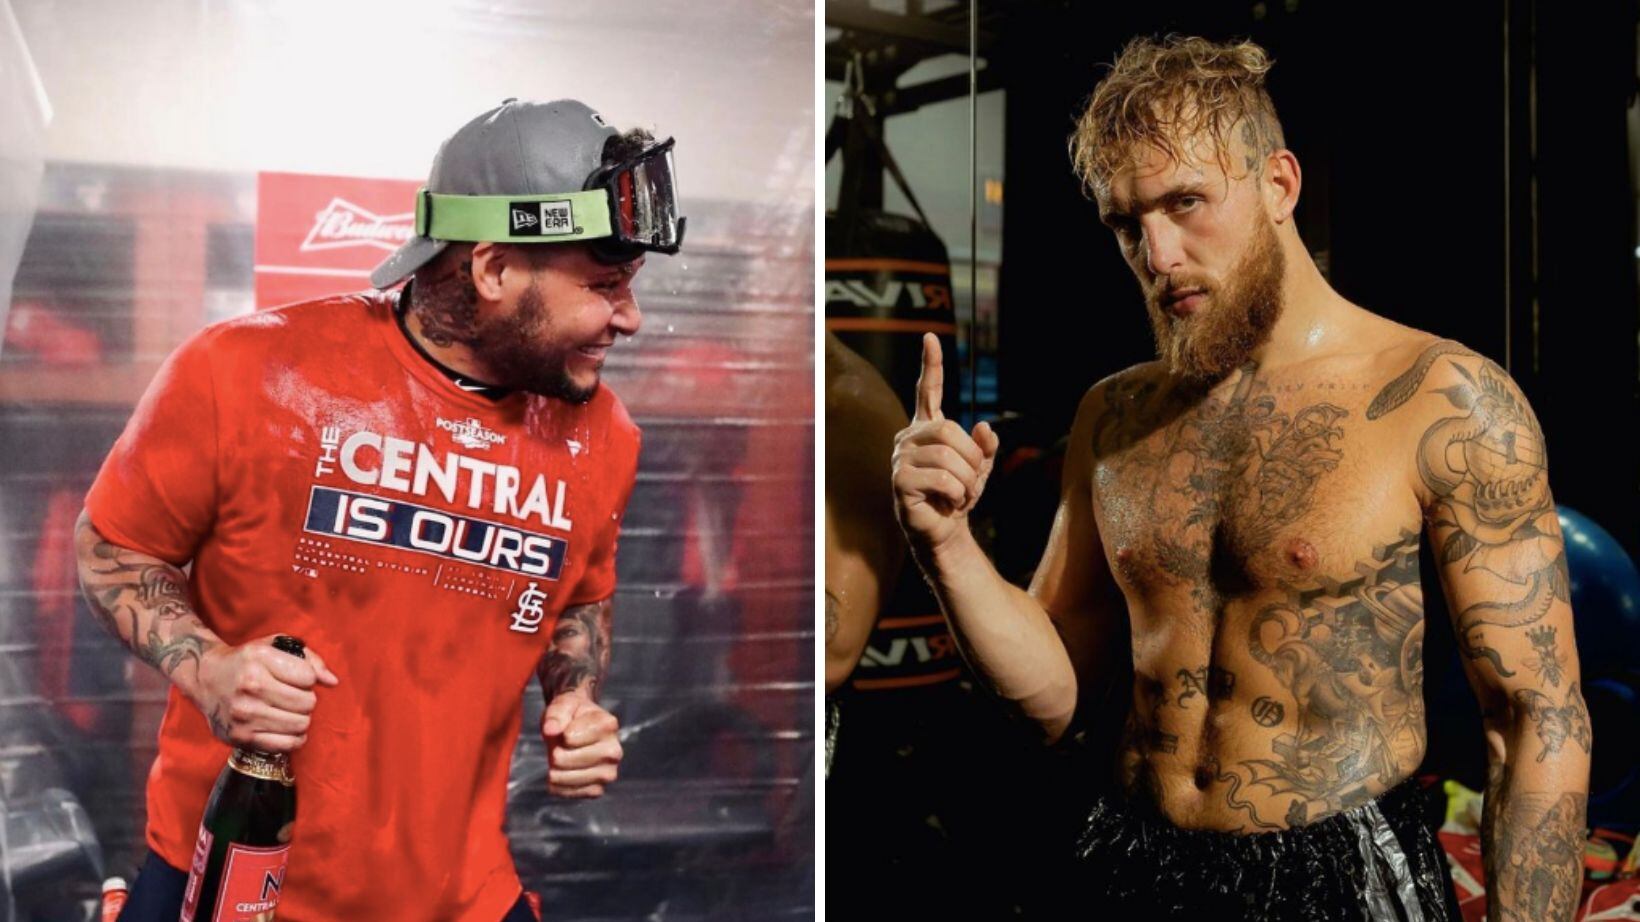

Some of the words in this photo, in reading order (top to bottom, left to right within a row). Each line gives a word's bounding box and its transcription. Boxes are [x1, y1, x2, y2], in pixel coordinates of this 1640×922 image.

[544, 208, 569, 218] NEW
[545, 218, 569, 228] ERA
[436, 417, 506, 445] POSTSEASON
[315, 426, 340, 478] THE
[339, 431, 572, 531] CENTRAL
[333, 494, 391, 541] IS
[409, 510, 552, 576] OURS
